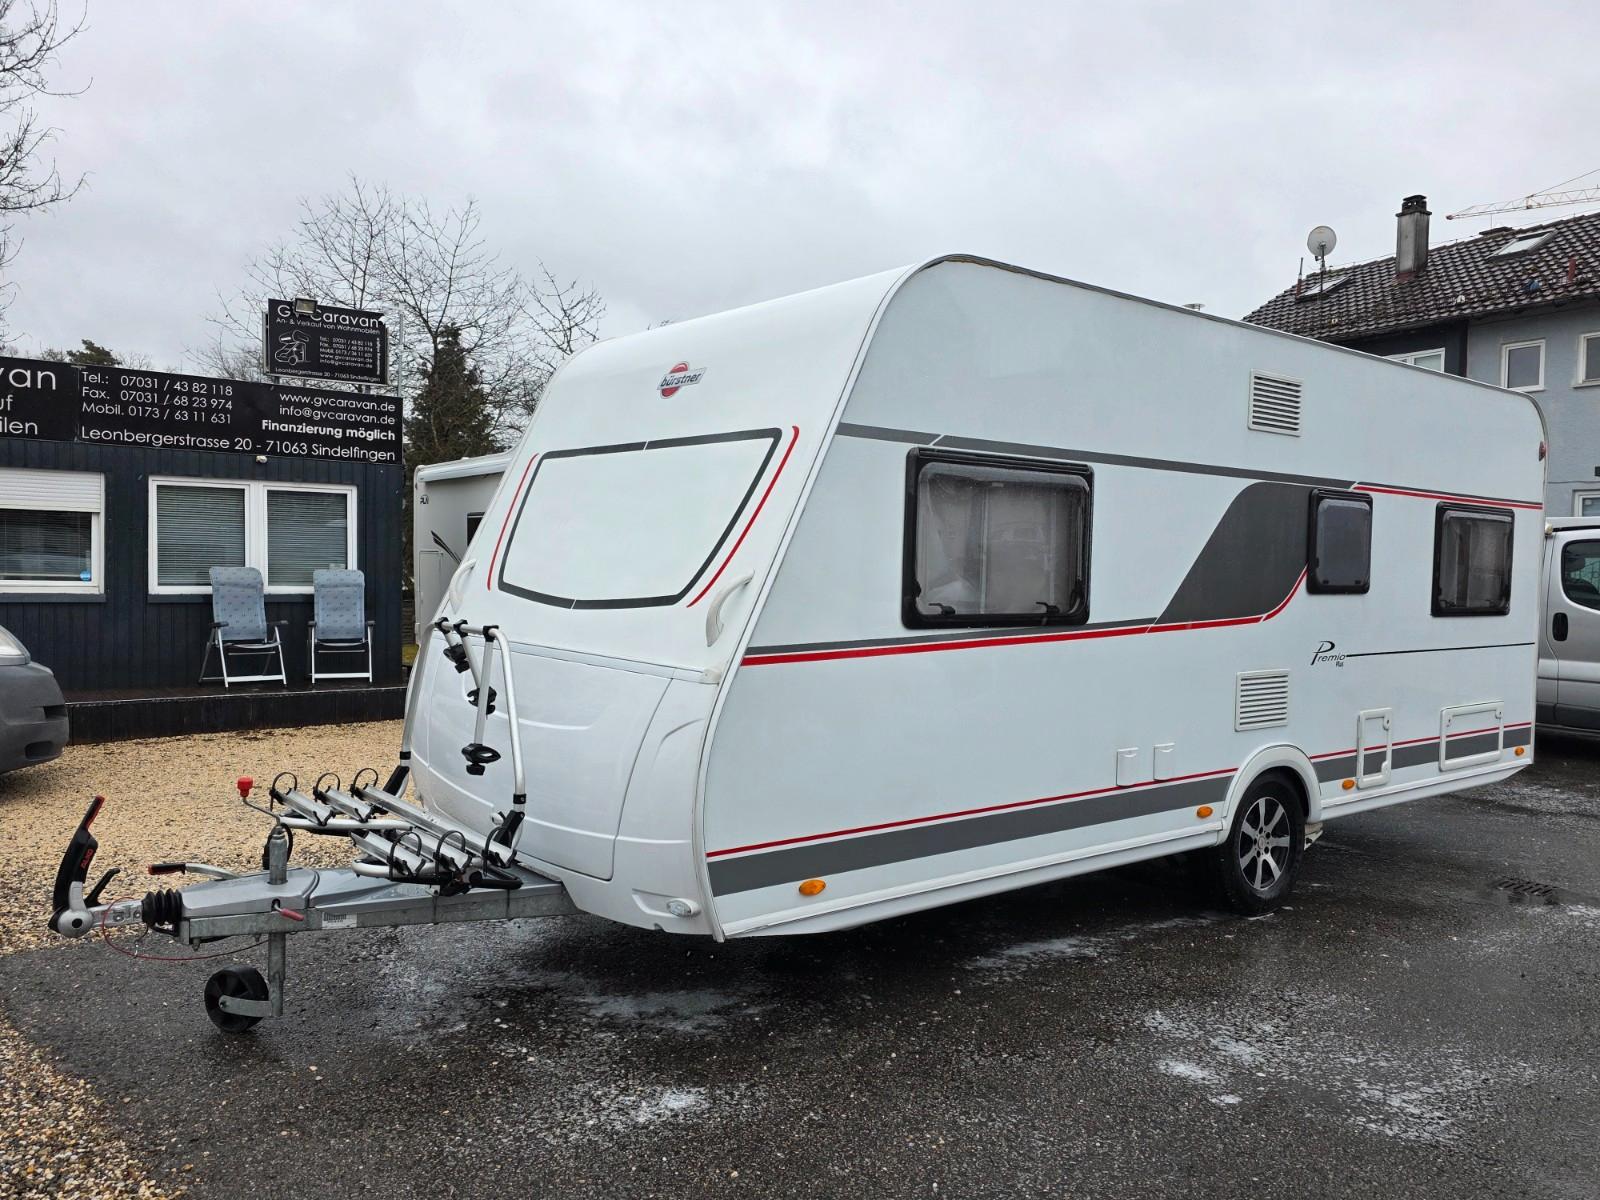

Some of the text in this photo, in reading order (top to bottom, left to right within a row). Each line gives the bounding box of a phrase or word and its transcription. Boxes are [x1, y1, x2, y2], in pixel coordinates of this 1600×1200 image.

[0, 368, 56, 390] an
[82, 372, 233, 396] Tel.: 07031 / 43 82 118
[660, 373, 701, 387] bürstner
[82, 386, 232, 410] Fax. 07031 / 68 23 974
[280, 393, 395, 412] www.gvcaravan.de
[82, 402, 231, 424] Mobil. 0173 / 63 11 631
[279, 405, 395, 425] info@gvcaravan.de
[262, 420, 395, 441] Finanzierung möglich
[81, 426, 230, 449] Leonbergerstrasse
[234, 438, 252, 450] 20
[266, 440, 308, 455] 71063
[311, 443, 395, 462] Sindelfingen
[1310, 640, 1346, 665] Premio
